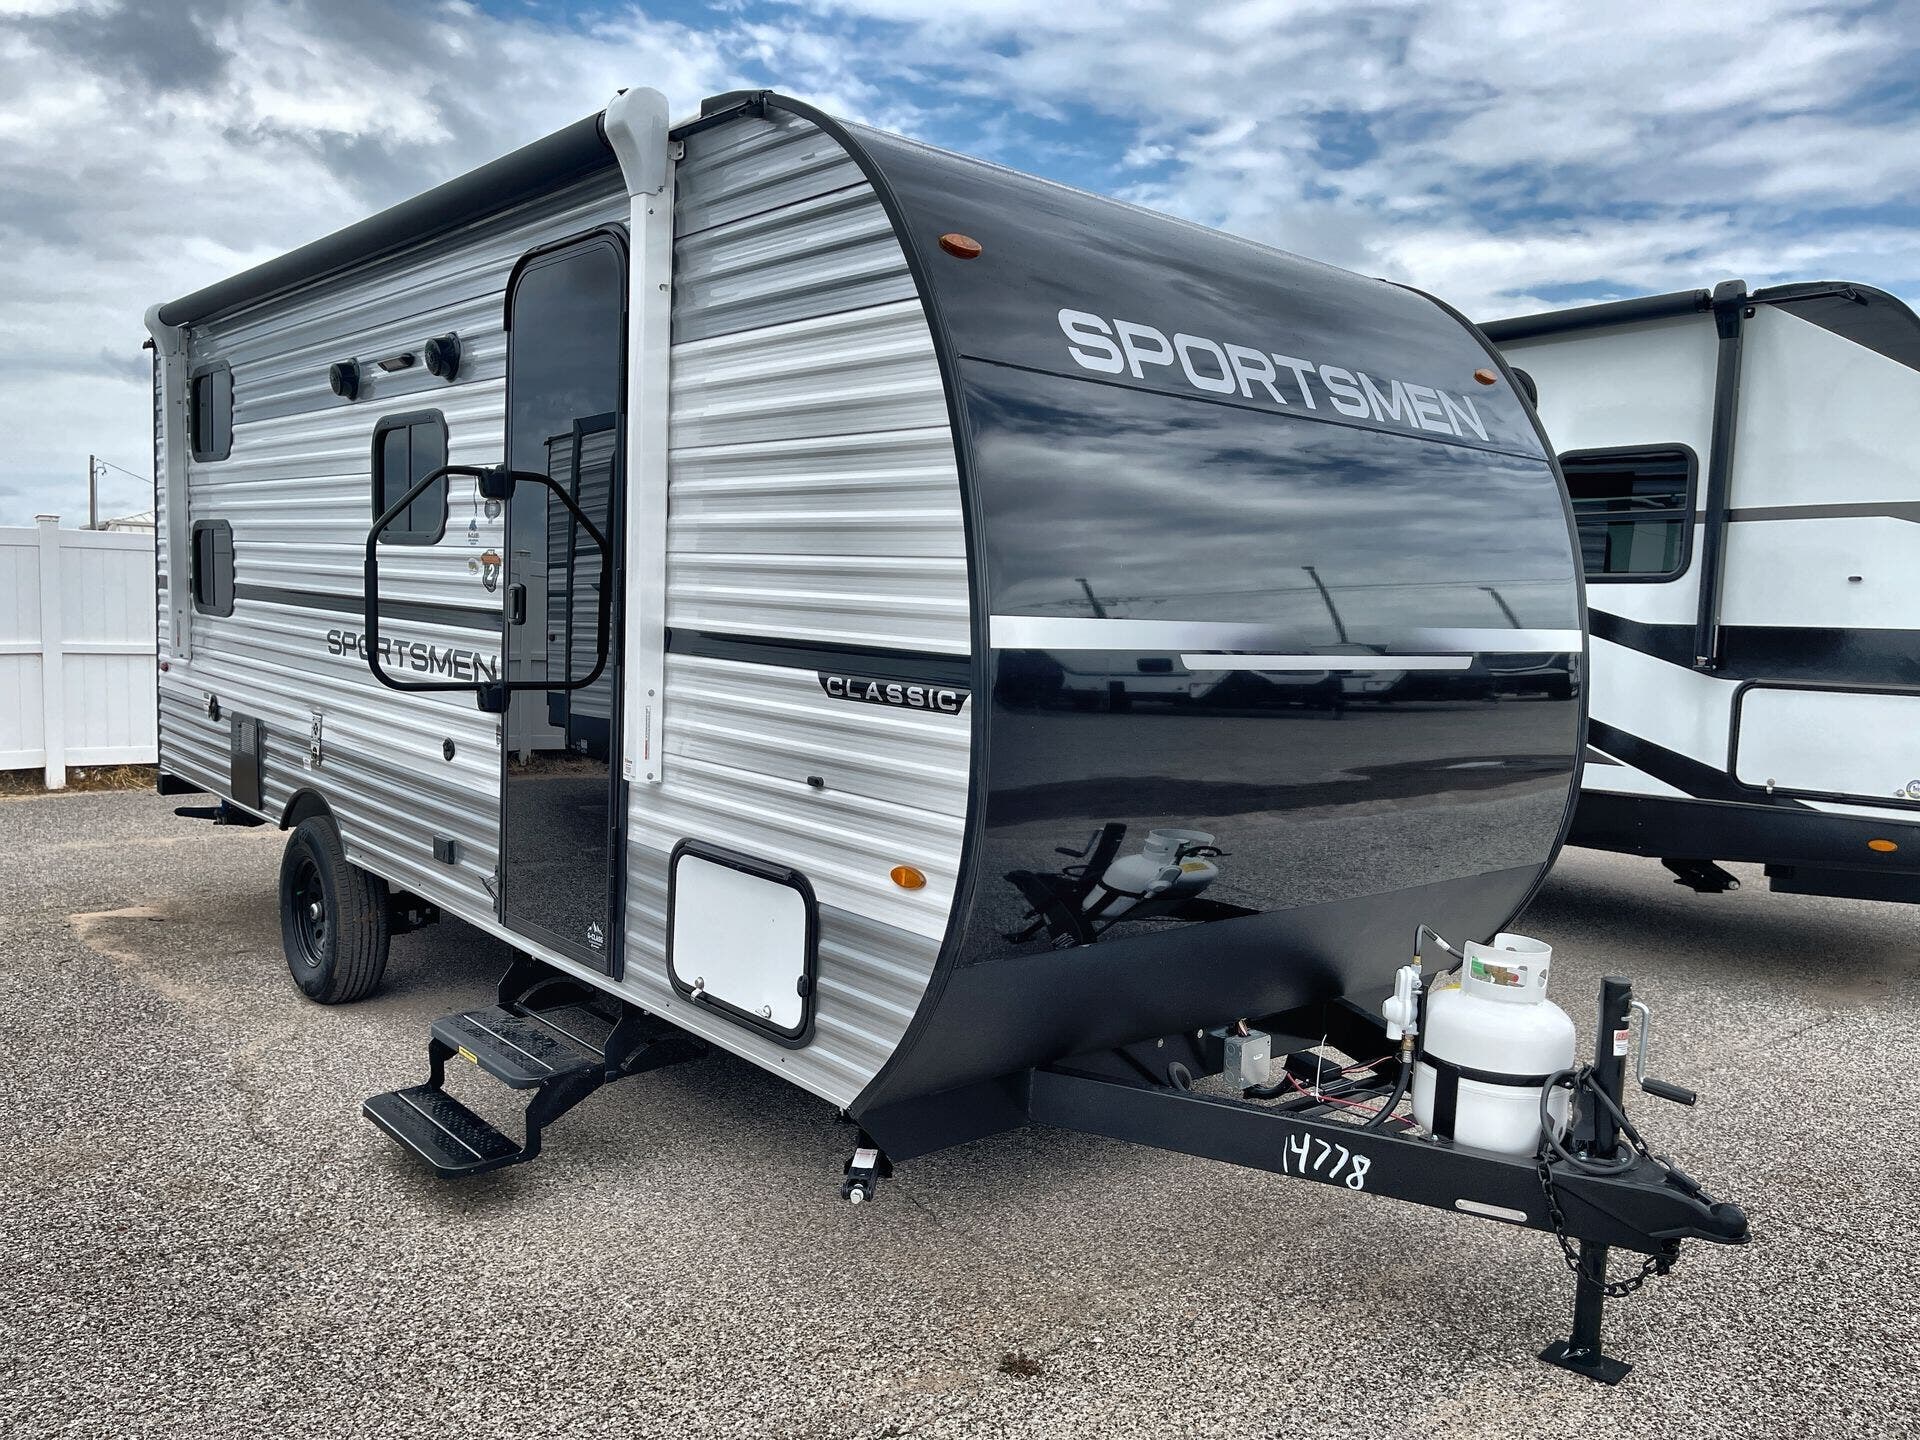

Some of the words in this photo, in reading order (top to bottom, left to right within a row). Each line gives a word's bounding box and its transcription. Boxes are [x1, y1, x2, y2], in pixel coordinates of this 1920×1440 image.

[1057, 308, 1490, 442] SPORTSMEN
[487, 564, 495, 580] 2
[827, 676, 957, 711] CLASSIC
[1283, 1132, 1372, 1191] 14778
